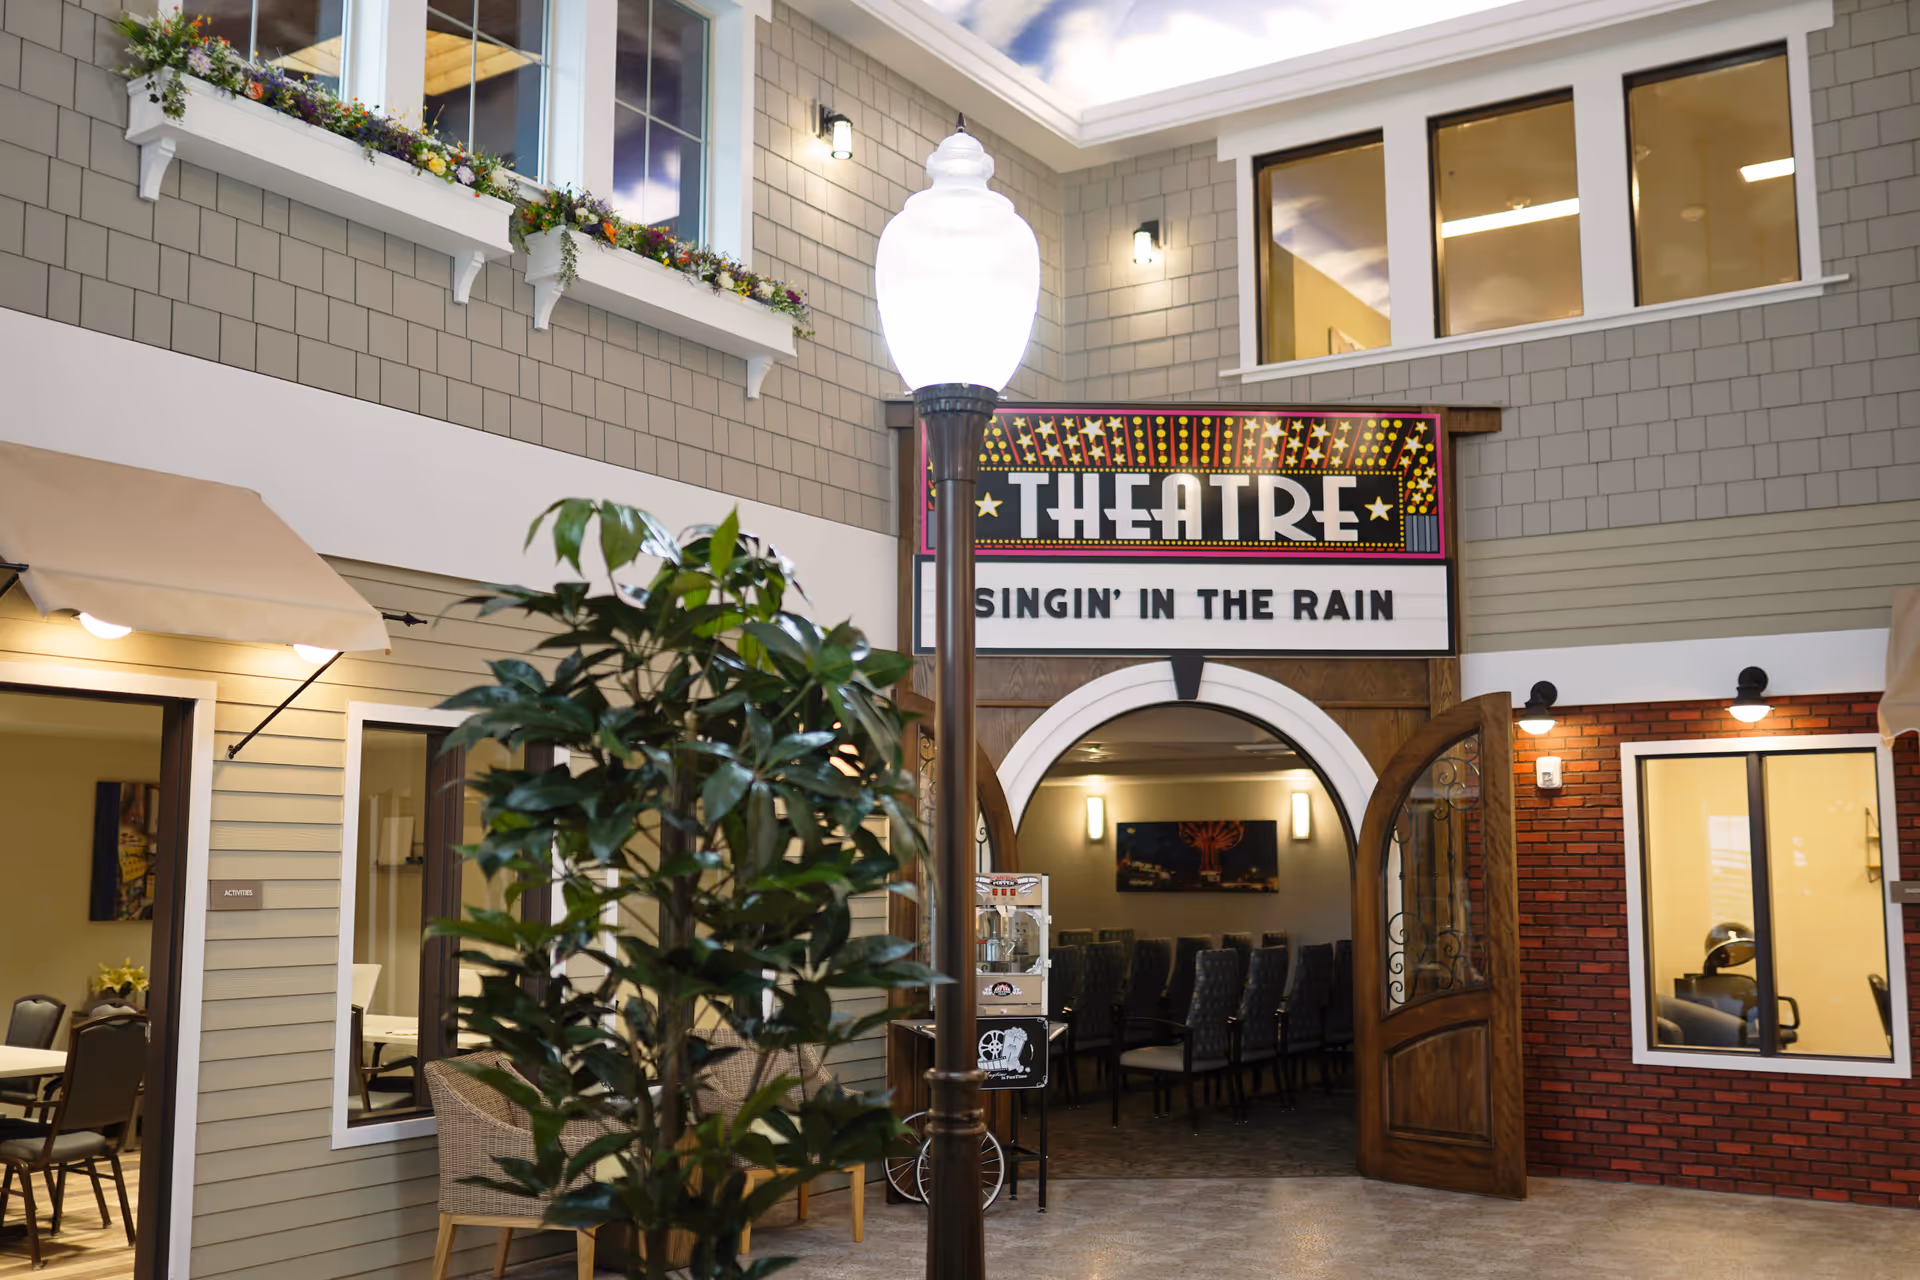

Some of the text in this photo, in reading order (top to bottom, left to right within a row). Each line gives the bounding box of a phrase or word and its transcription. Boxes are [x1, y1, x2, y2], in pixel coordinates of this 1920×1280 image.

[1007, 472, 1360, 542] THEATRE
[1140, 588, 1175, 620] IN
[1197, 589, 1274, 620] THE
[1293, 589, 1394, 621] RAIN
[224, 889, 253, 897] ACTIVITIES
